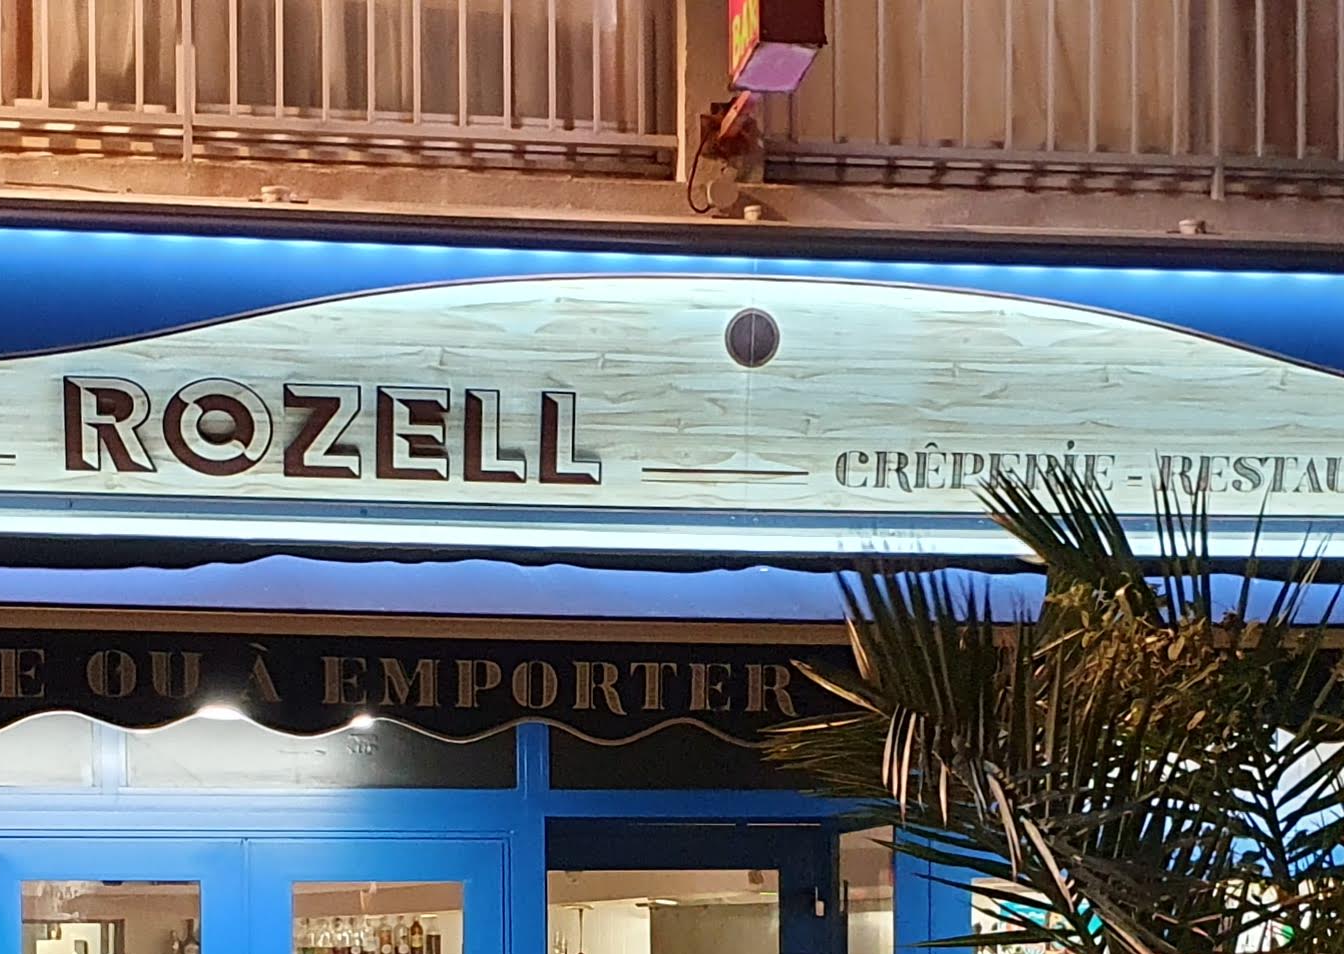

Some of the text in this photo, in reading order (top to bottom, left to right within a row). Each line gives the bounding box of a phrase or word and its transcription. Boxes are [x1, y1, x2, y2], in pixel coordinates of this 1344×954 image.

[62, 375, 603, 486] ROZELL
[834, 439, 1116, 493] CRÊPERIE
[85, 648, 202, 700] OU
[247, 641, 281, 702] À
[321, 653, 798, 718] EMPORTER
